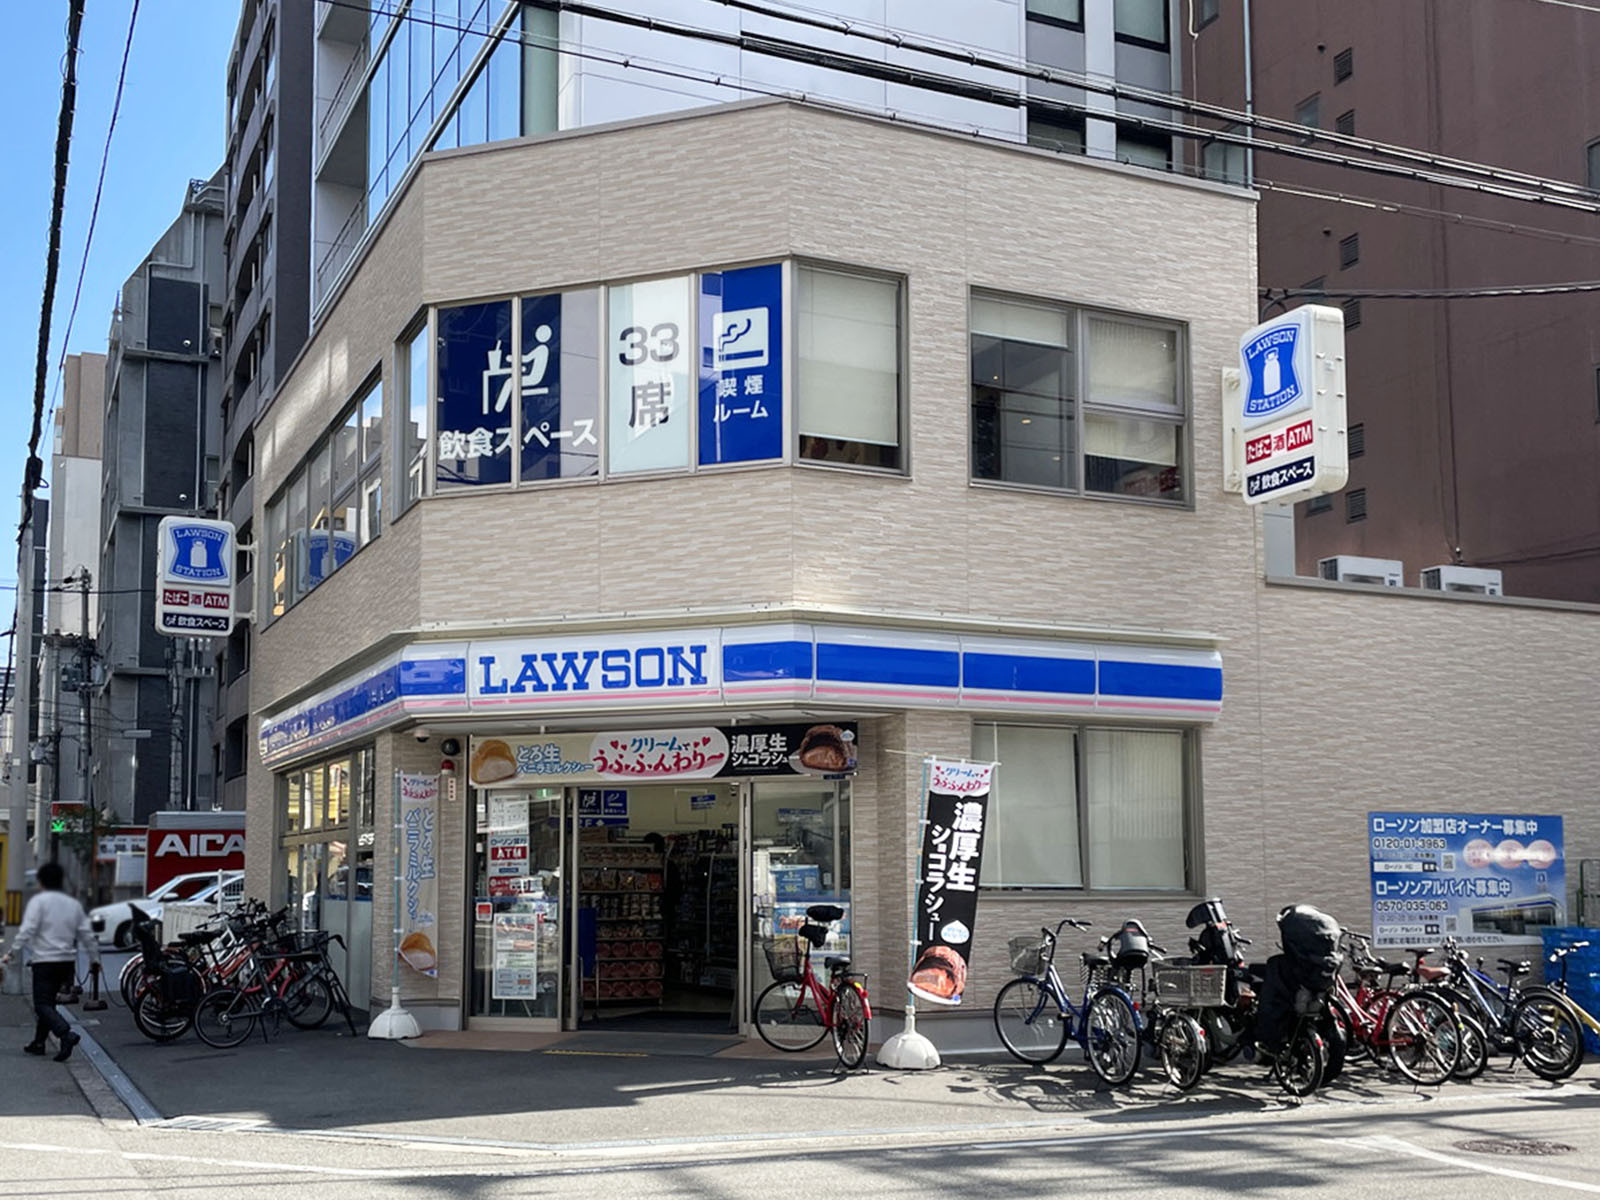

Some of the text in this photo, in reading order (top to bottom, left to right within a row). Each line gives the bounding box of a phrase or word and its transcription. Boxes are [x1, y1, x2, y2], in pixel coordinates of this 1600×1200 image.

[618, 322, 681, 366] 33
[1246, 329, 1296, 359] LAWSON
[716, 374, 764, 398] 喫煙
[1249, 384, 1297, 412] STATION
[628, 381, 672, 428] 席
[713, 400, 769, 423] ルーム
[438, 418, 598, 461] 飲食スペース
[1247, 438, 1271, 462] たばこ
[1287, 424, 1312, 448] ATM
[1261, 461, 1313, 490] 飲食スペース
[175, 528, 224, 542] LAWSON
[174, 564, 221, 577] STATION
[204, 595, 228, 607] ATM
[478, 645, 708, 695] LAWSON
[517, 743, 560, 763] とろ生
[630, 736, 690, 753] クリームで
[731, 733, 787, 753] 濃厚生
[1373, 817, 1538, 836] ローソン加盟店オーナー募集中
[154, 833, 245, 857] AICA
[497, 848, 522, 858] ATM
[945, 802, 983, 892] 濃厚生
[924, 824, 951, 941] ショコラシュー
[1375, 879, 1512, 896] ローソンアルバイト募集中
